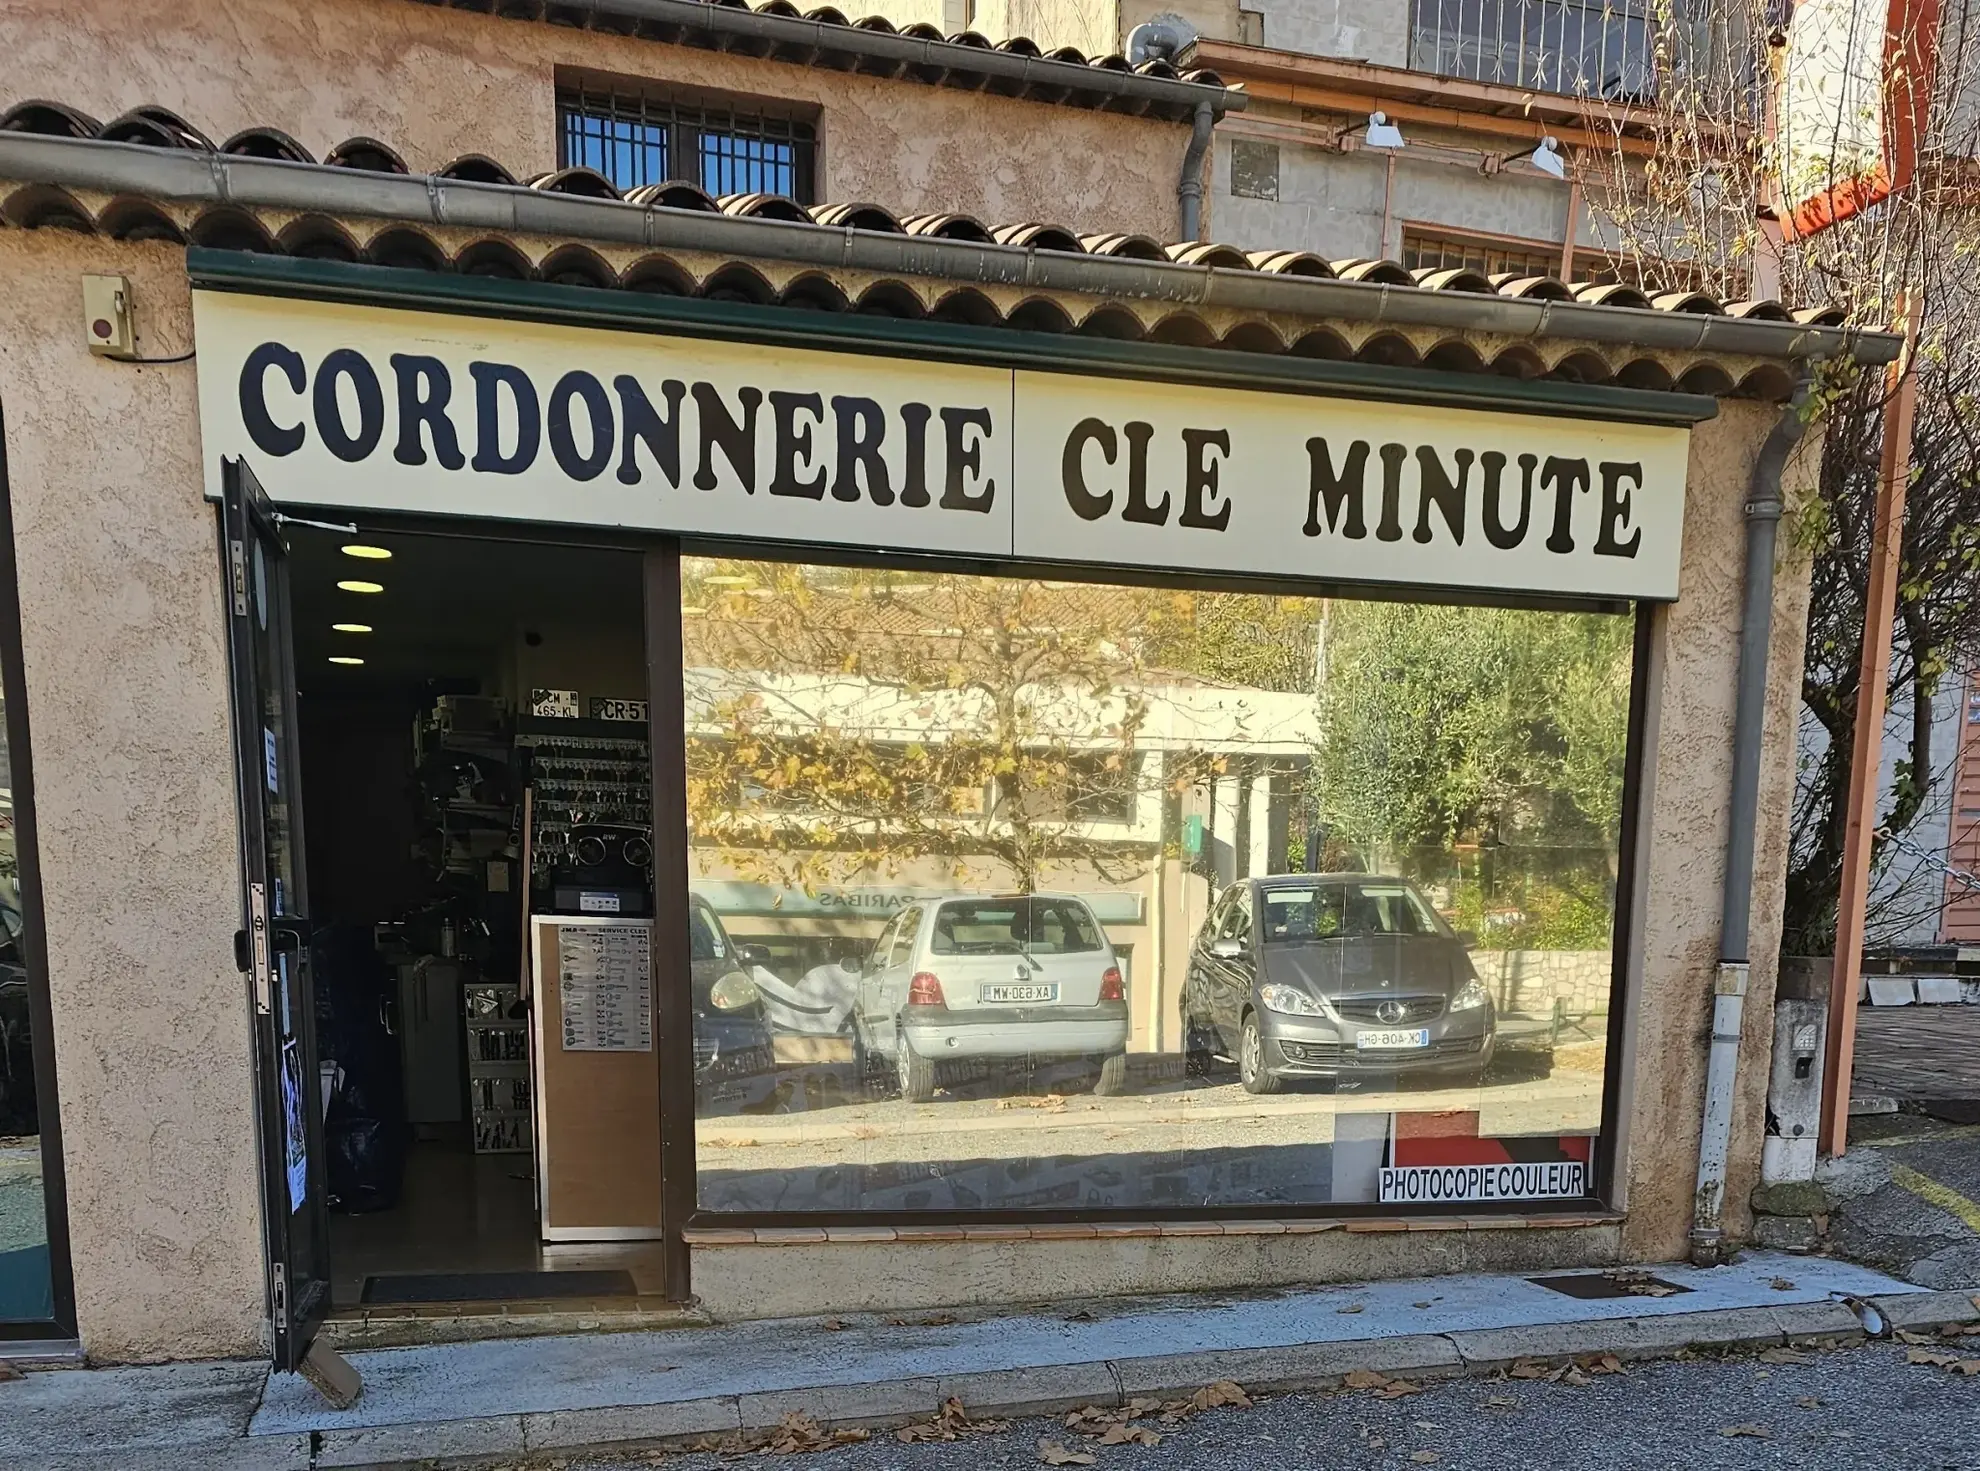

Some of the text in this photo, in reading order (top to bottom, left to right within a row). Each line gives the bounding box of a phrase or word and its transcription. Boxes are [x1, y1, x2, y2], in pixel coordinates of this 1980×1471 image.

[239, 341, 1642, 559] CORDONNERIE CLE MINUTE
[1381, 1164, 1583, 1200] PHOTOCOPIE COULEUR
